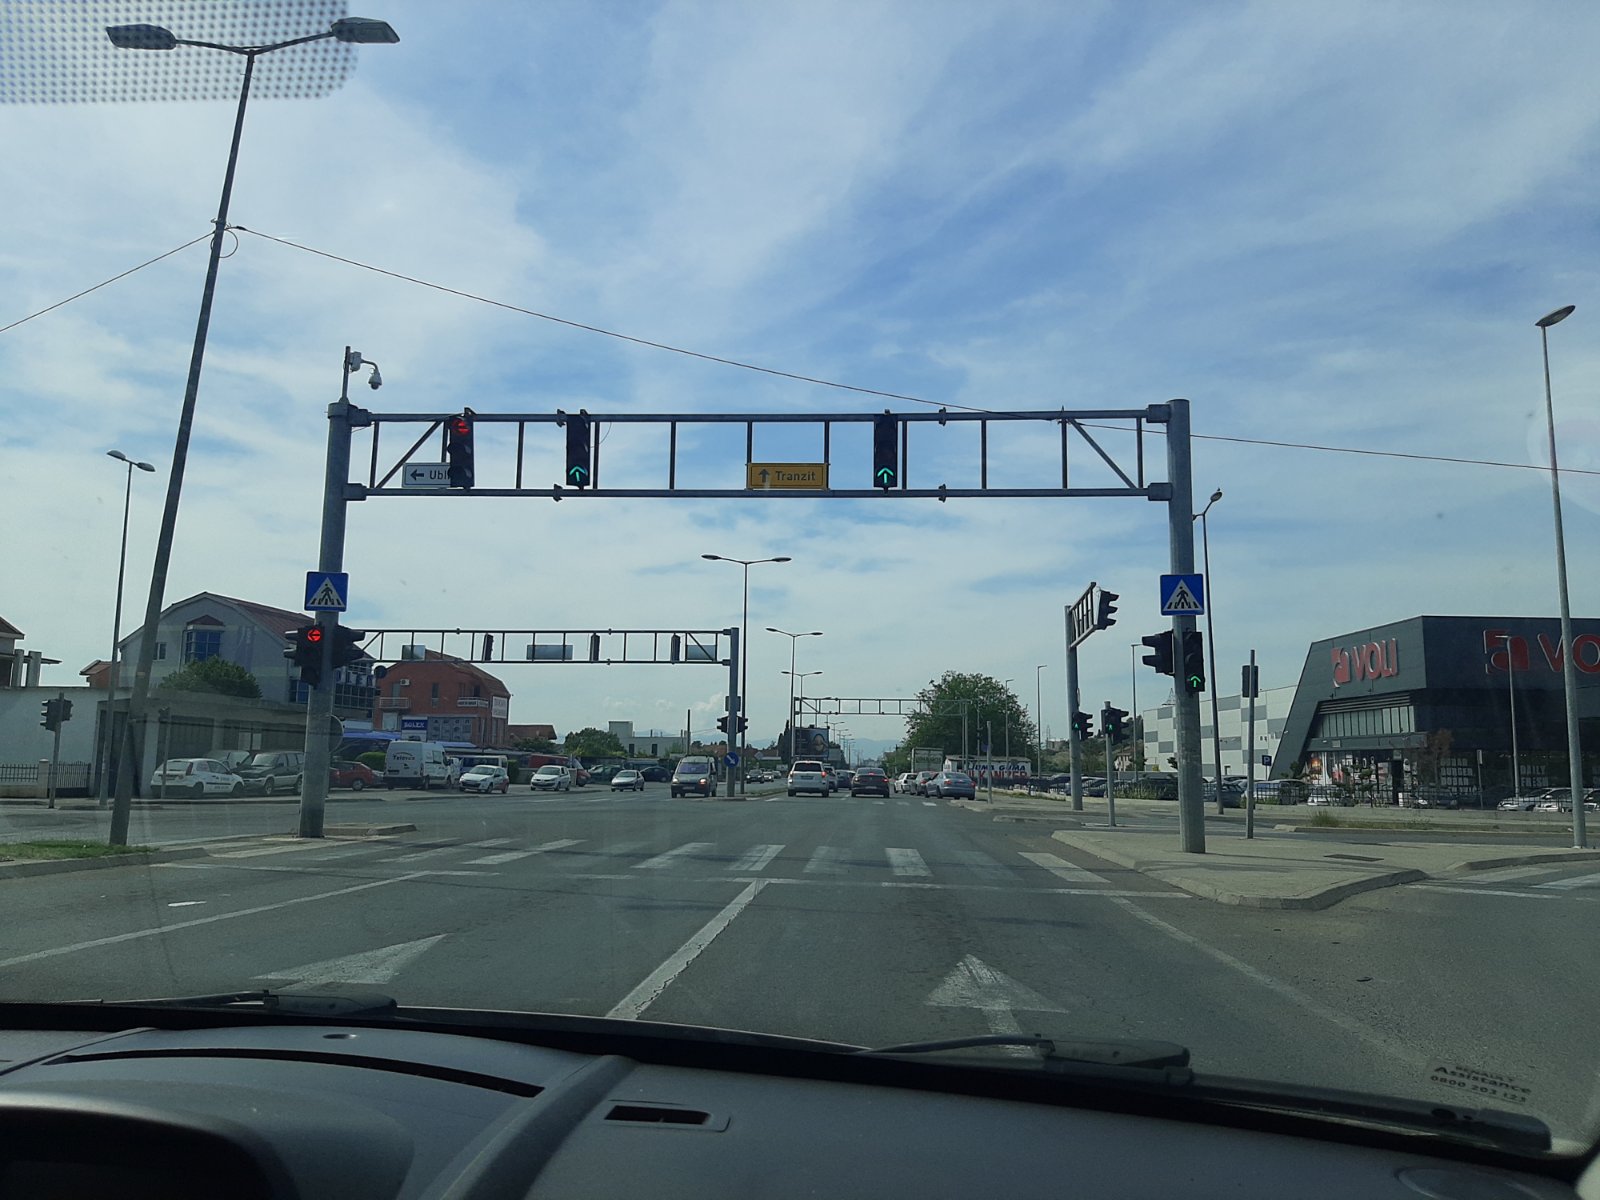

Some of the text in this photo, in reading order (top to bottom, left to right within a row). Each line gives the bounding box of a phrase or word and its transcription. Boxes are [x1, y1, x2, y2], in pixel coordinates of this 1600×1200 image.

[775, 470, 816, 481] Tranzit
[1352, 637, 1398, 681] VOLI
[1430, 1075, 1466, 1088] 0800
[1434, 1066, 1532, 1094] Assistance
